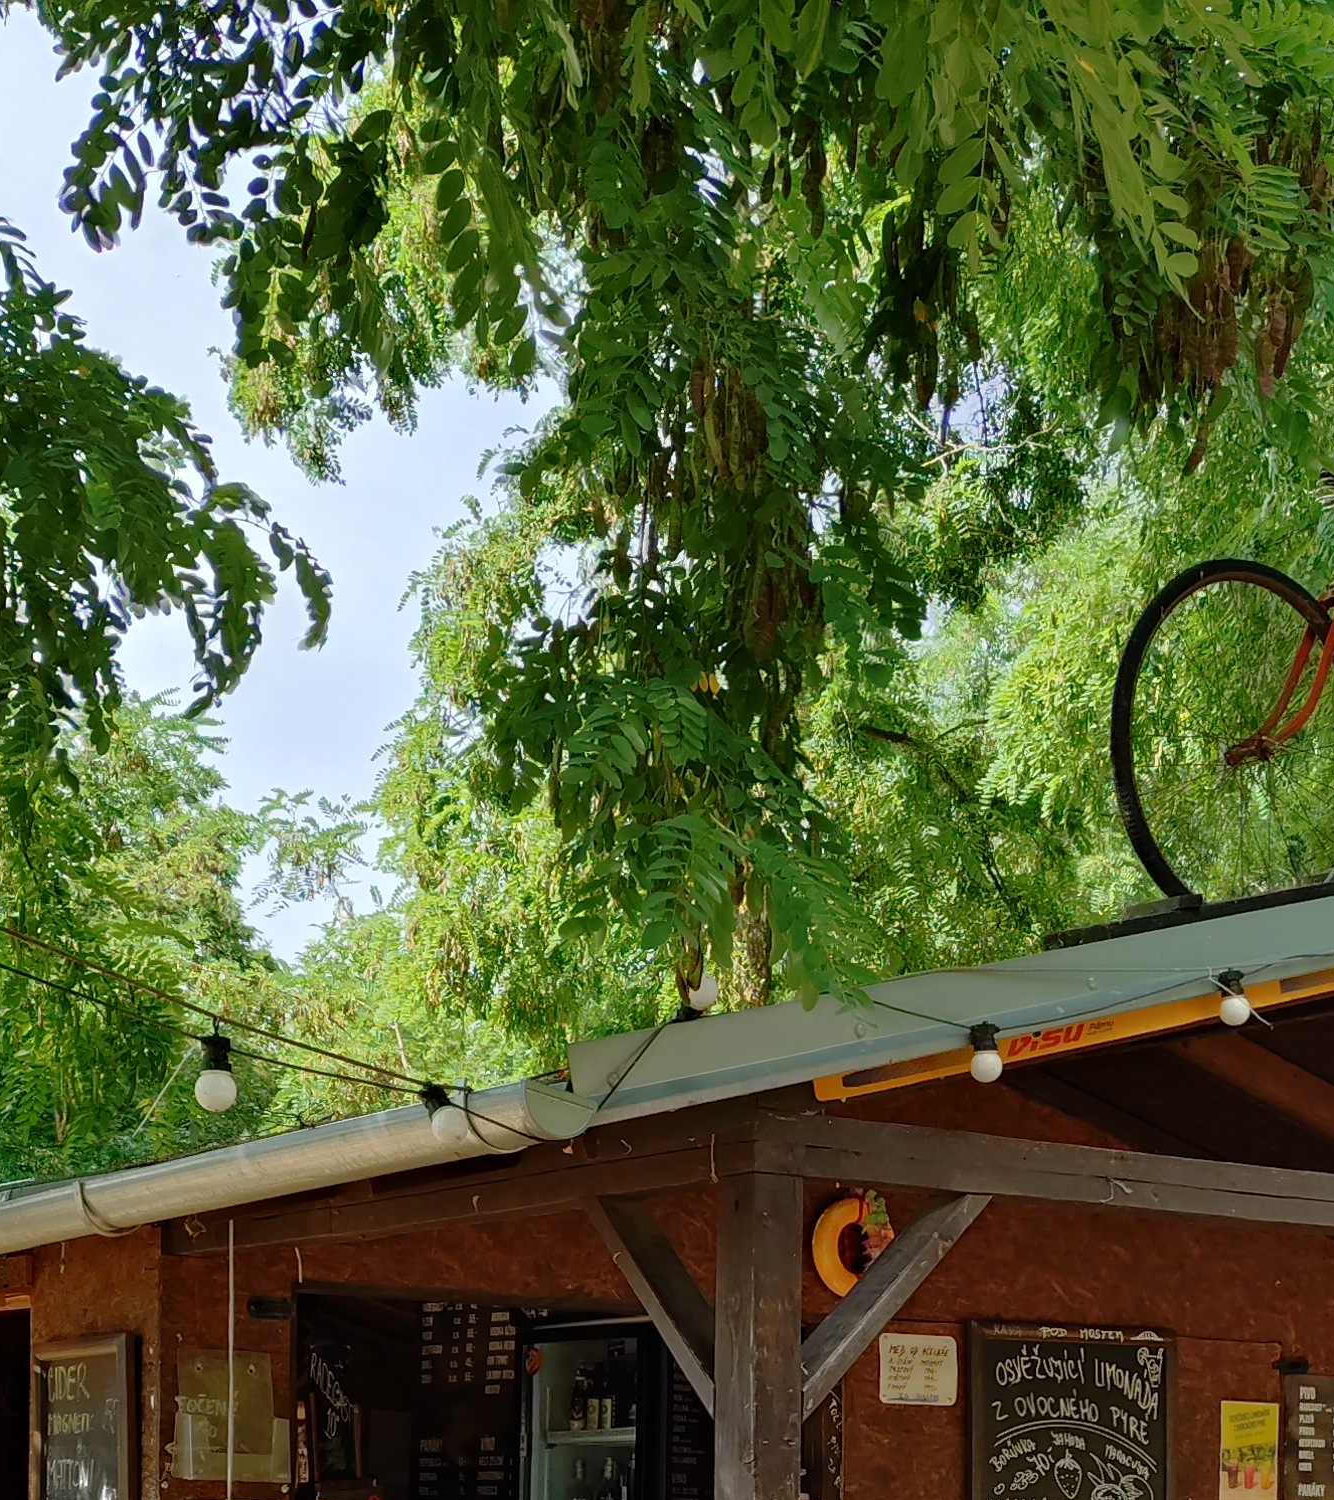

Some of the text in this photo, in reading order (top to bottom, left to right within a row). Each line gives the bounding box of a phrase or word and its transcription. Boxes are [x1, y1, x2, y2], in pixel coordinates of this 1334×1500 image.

[47, 1361, 91, 1403] CIDER
[310, 1353, 354, 1422] RADEGAST
[991, 1400, 1008, 1421] Z
[1014, 1388, 1100, 1422] OVOCNÉHO
